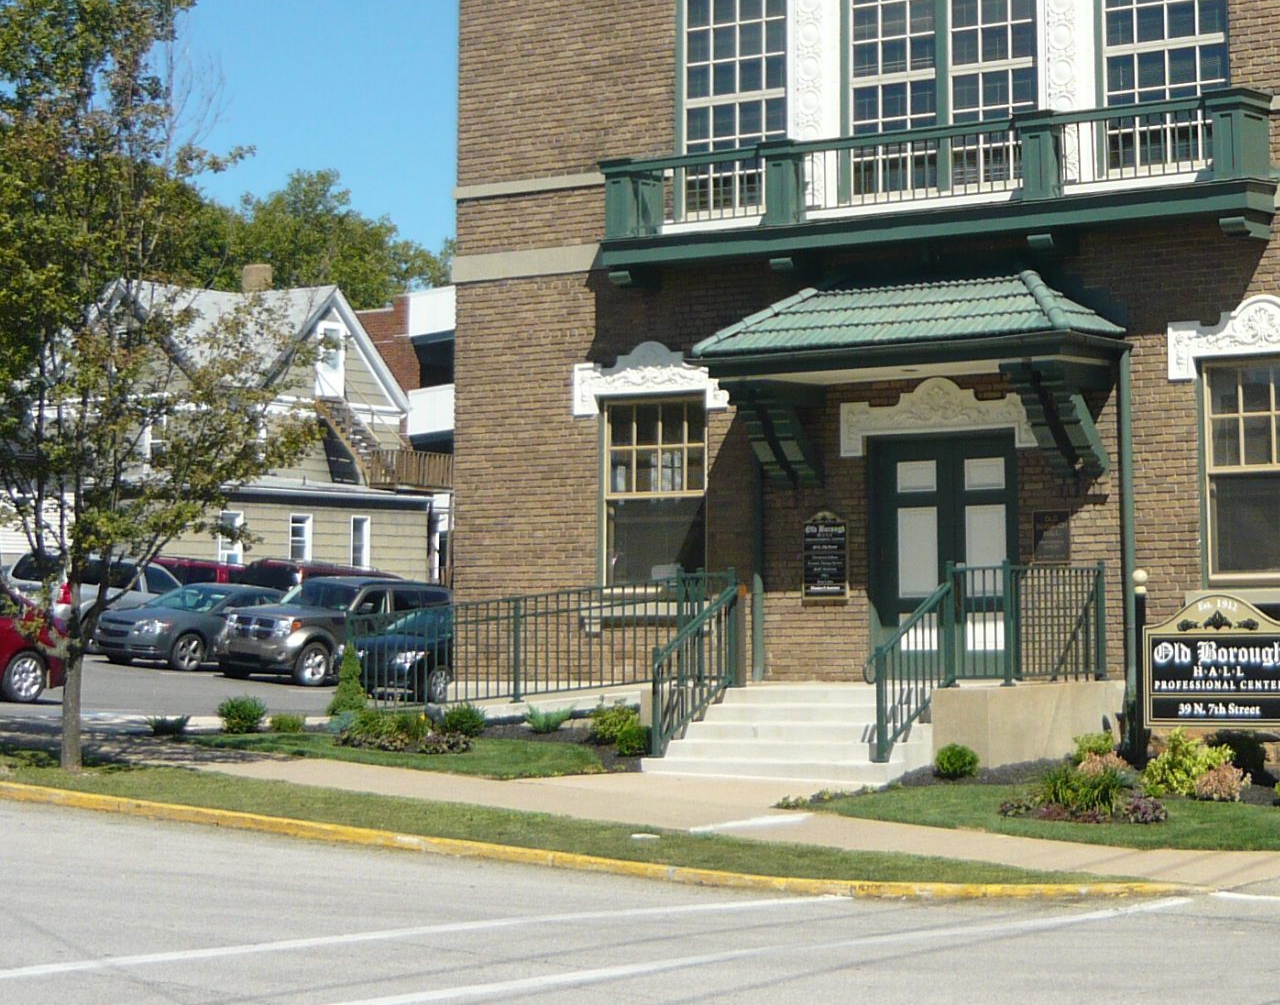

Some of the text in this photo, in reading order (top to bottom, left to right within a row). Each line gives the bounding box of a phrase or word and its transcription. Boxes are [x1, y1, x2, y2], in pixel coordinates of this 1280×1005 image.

[1216, 599, 1238, 612] 1912
[1153, 642, 1191, 663] Old
[1154, 680, 1236, 690] PROFESSIONAL
[1178, 702, 1261, 715] 39 N. 7th Street
